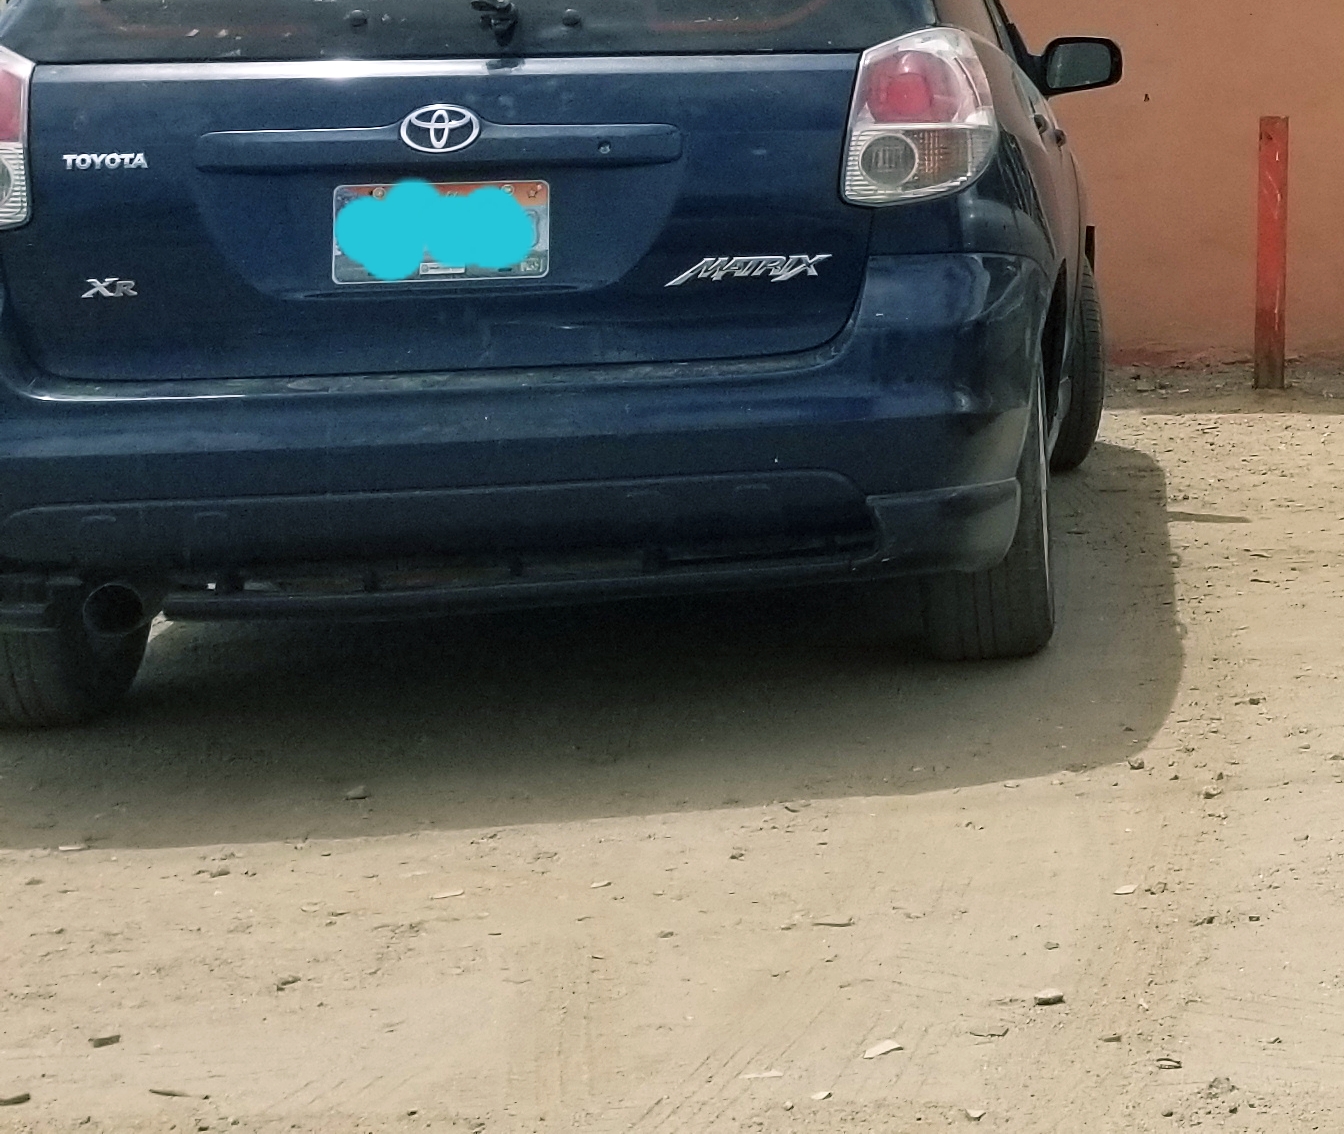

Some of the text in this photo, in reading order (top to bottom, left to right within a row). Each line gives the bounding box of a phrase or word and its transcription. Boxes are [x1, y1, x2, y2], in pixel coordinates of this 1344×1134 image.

[62, 152, 149, 170] TOYOTA
[664, 254, 833, 287] MATRIX
[81, 277, 138, 298] XR
